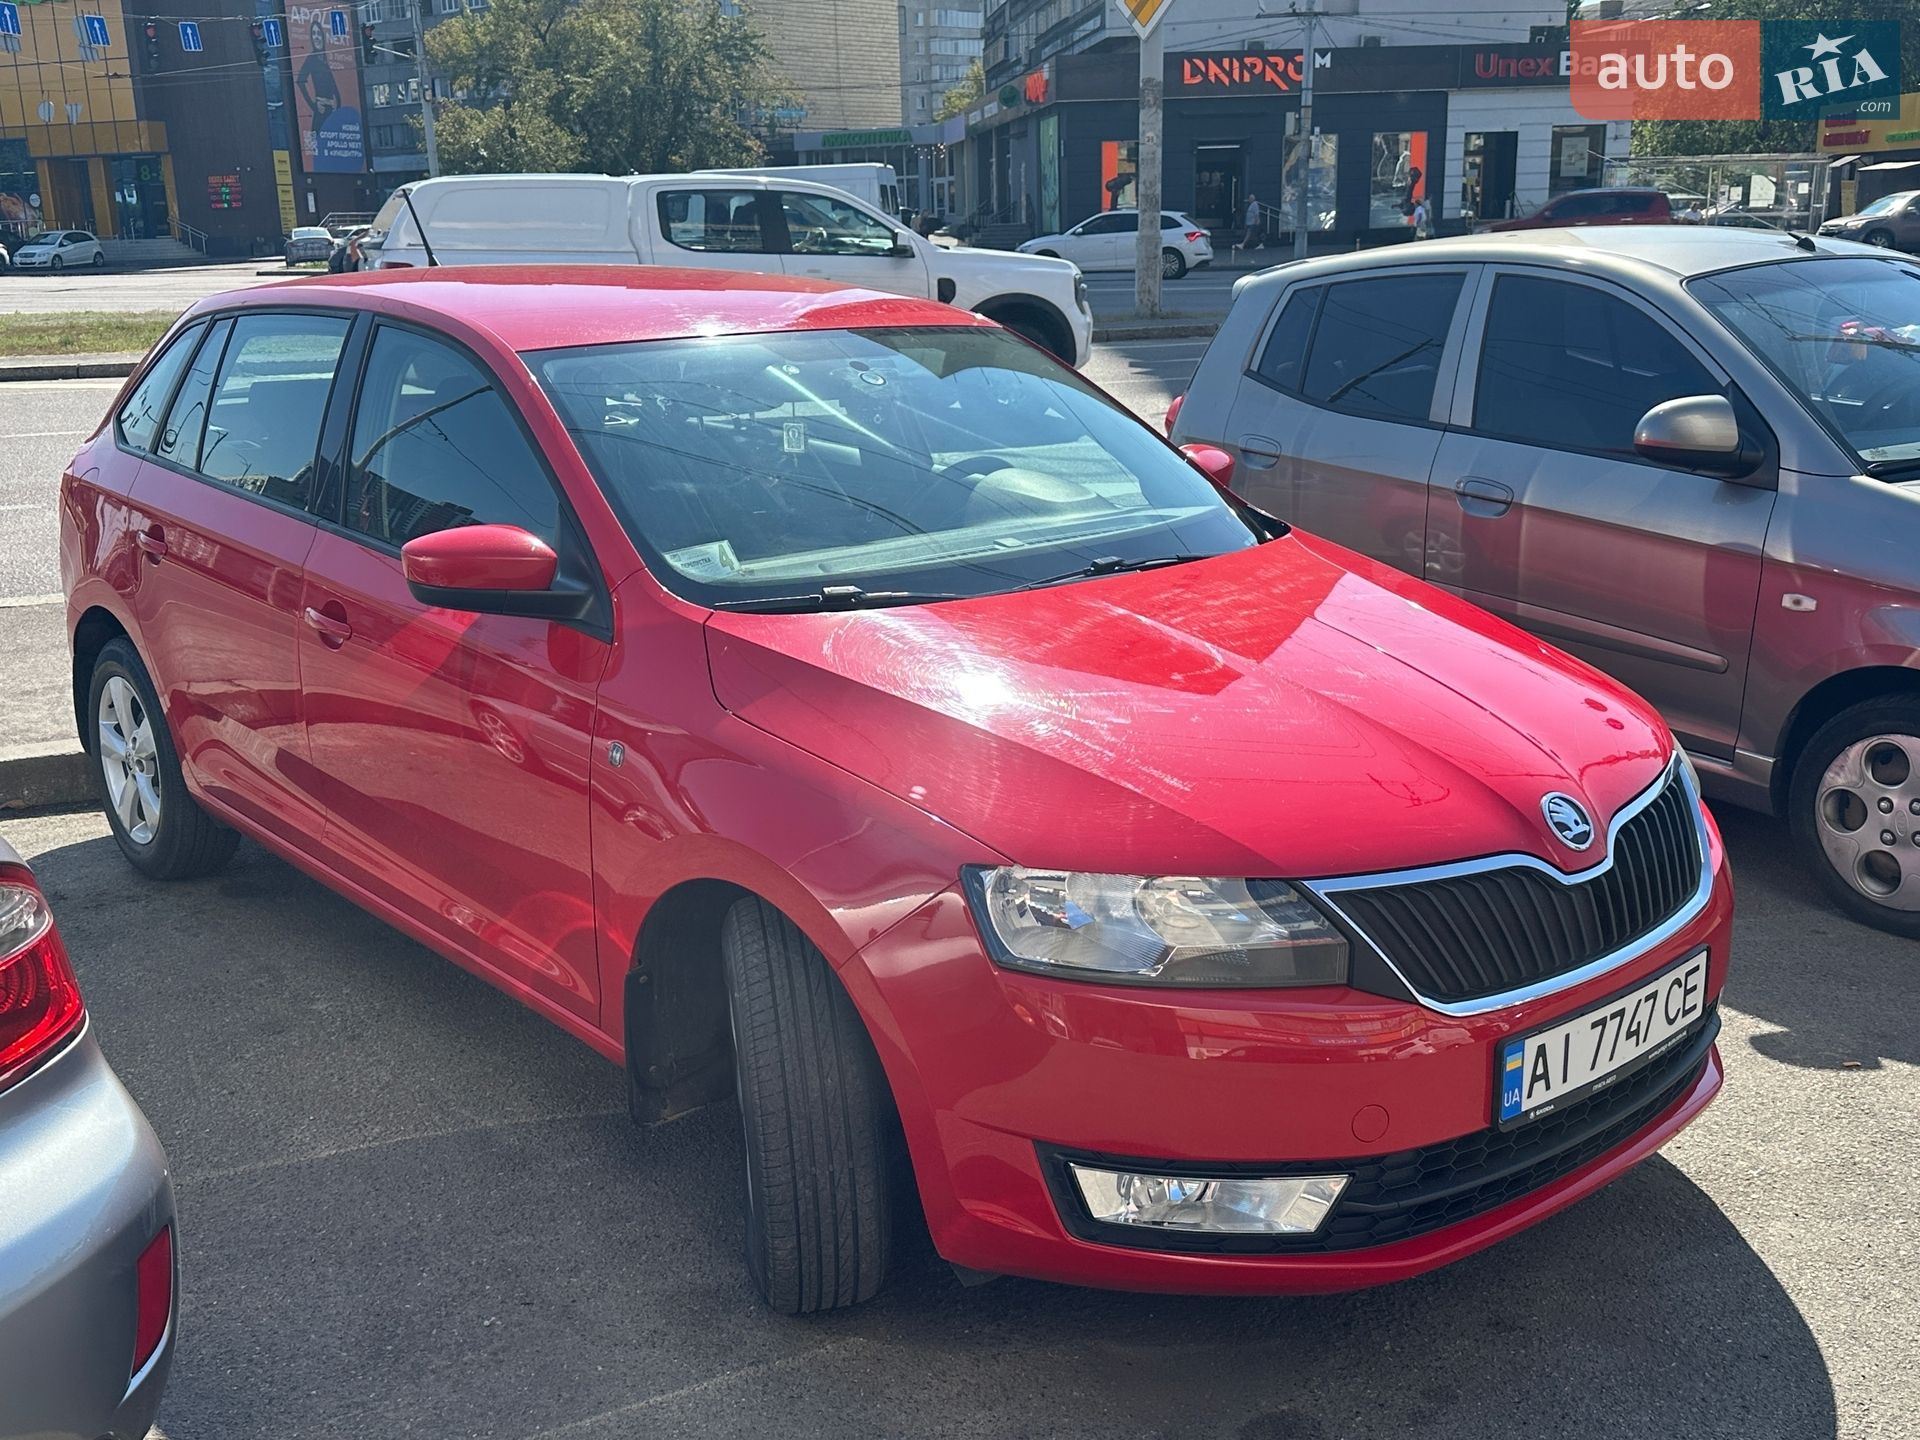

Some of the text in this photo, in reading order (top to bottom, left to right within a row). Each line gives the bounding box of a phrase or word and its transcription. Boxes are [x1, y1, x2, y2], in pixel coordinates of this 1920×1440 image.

[1183, 54, 1304, 91] DNIPRO
[1475, 52, 1554, 78] Unex
[822, 130, 912, 147] ЛЮКСОПТИКА
[1526, 964, 1700, 1099] AI 7747 CE
[1504, 1092, 1521, 1107] UA
